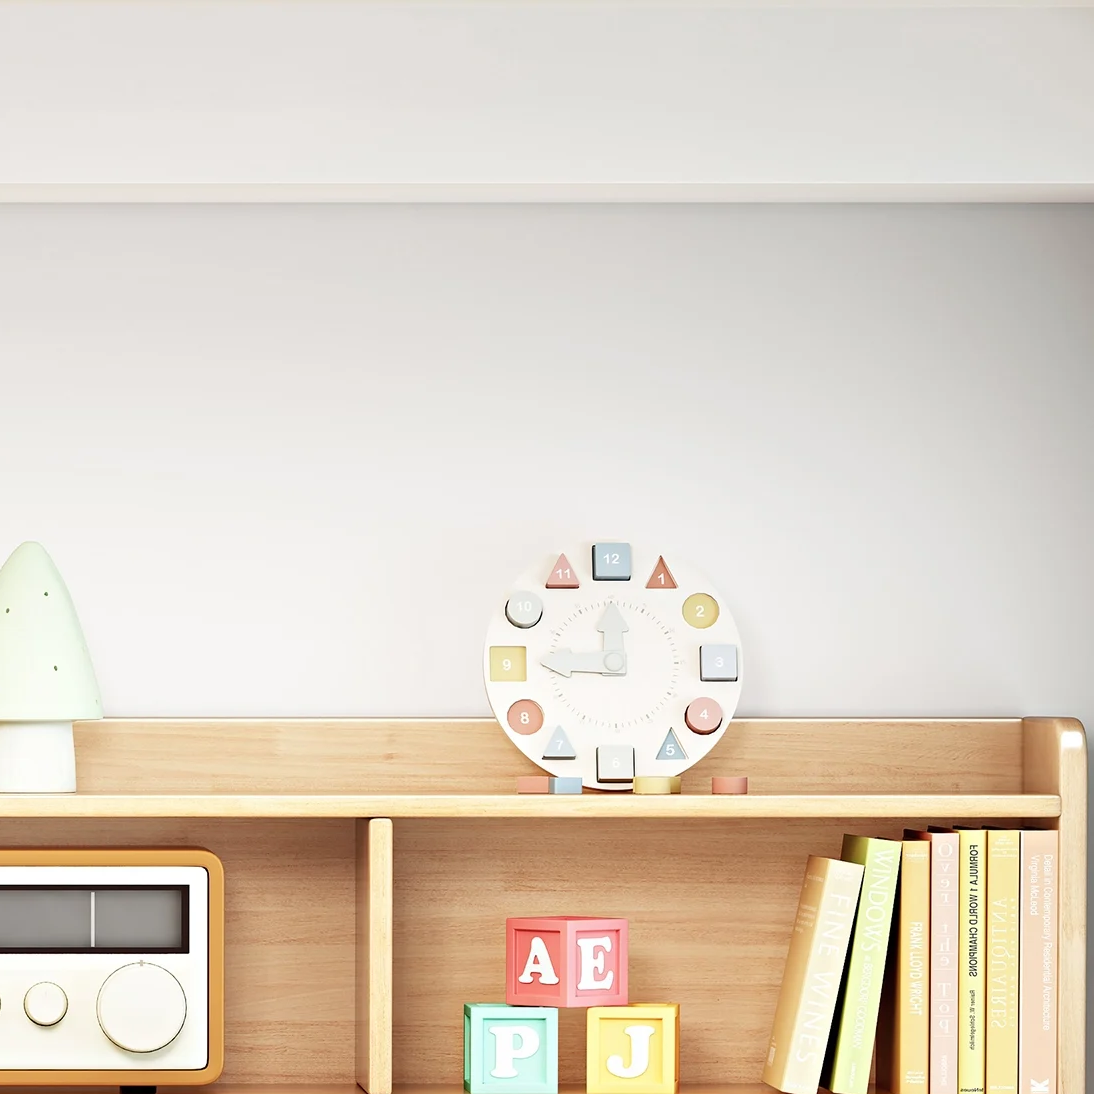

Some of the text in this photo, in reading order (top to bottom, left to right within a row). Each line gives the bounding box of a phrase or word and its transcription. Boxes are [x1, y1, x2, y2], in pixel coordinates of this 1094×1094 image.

[603, 553, 620, 565] 12
[556, 568, 571, 580] 11
[657, 572, 666, 585] 1
[517, 600, 533, 613] 10
[695, 605, 705, 618] 2
[502, 658, 512, 671] 9
[715, 655, 724, 668] 3
[520, 711, 530, 725] 8
[699, 708, 709, 720] 4
[556, 739, 564, 751] 7
[665, 743, 675, 756] 5
[612, 757, 620, 769] 6
[860, 849, 895, 951] WINDOWS
[518, 936, 560, 985] A
[577, 936, 614, 991] E
[909, 921, 923, 1016] FRANK LLOYD WRIGHT
[488, 1025, 540, 1079] P
[606, 1025, 656, 1079] J
